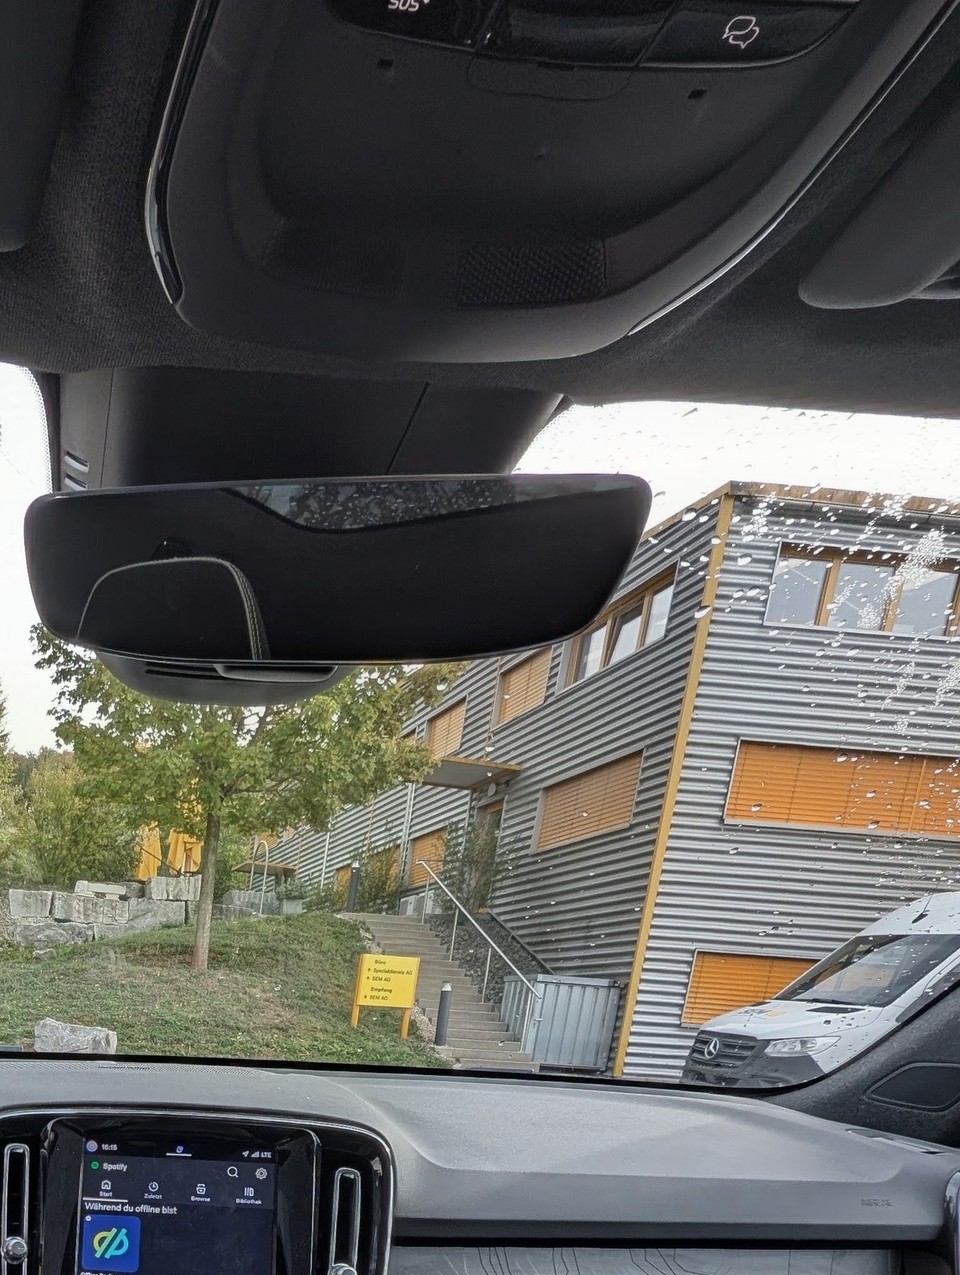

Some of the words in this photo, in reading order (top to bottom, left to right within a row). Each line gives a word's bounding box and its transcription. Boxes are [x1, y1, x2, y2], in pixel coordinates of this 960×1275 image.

[260, 1151, 272, 1159] LTE
[102, 1162, 128, 1172] Spotify
[84, 1202, 122, 1212] Während
[122, 1204, 134, 1213] du
[134, 1204, 161, 1214] offline
[161, 1205, 178, 1215] bist
